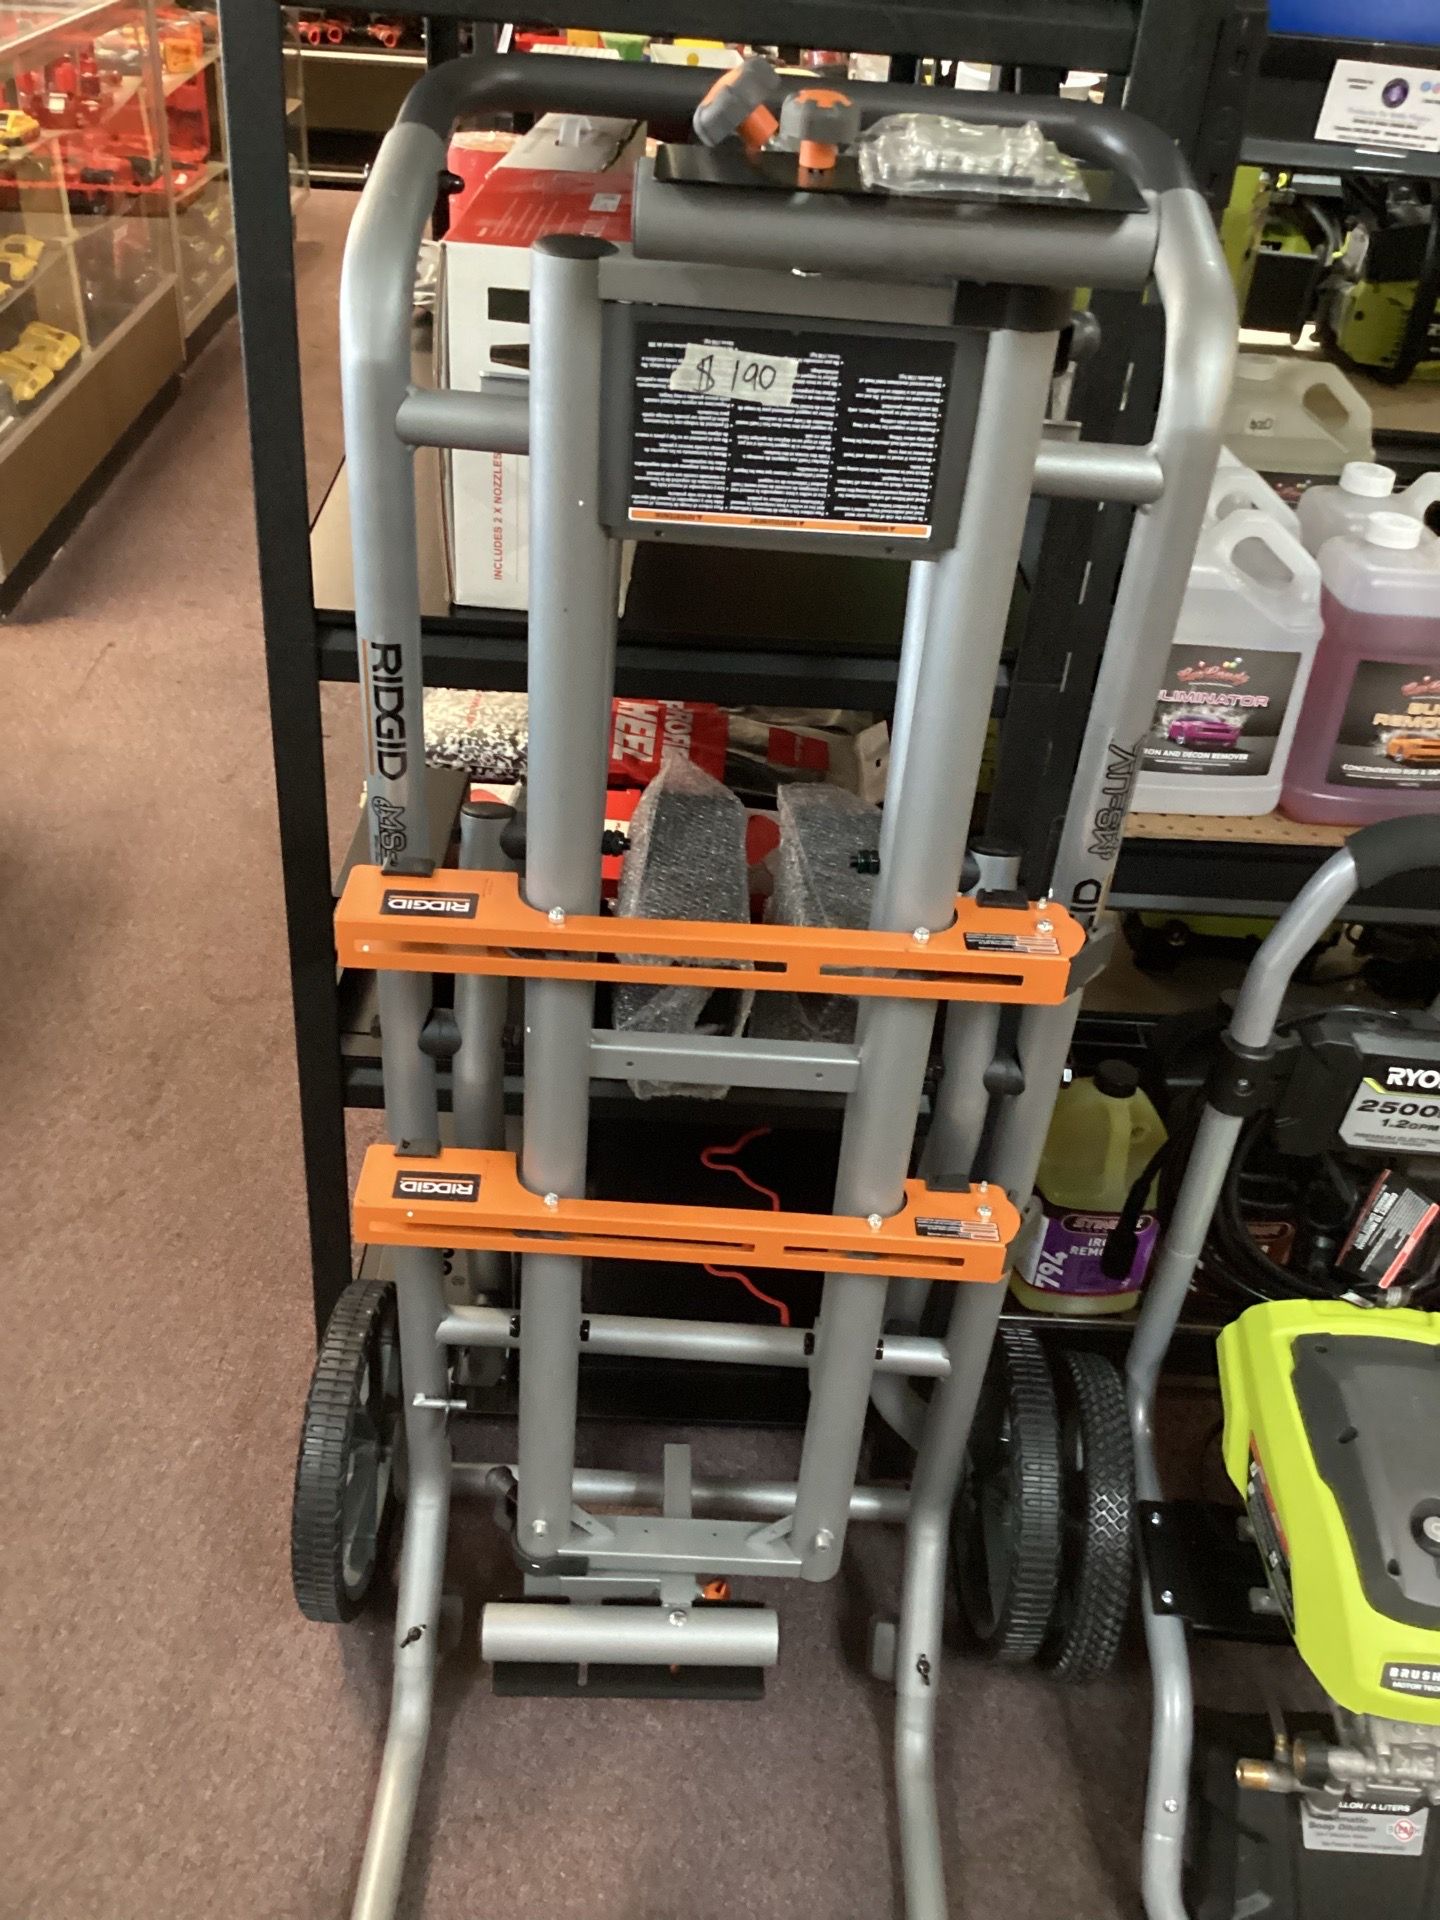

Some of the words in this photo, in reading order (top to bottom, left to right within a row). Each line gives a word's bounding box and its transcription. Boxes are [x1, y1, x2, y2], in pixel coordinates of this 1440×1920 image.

[493, 452, 503, 504] NOZZLES
[493, 526, 503, 580] INCLUDES
[1158, 689, 1269, 708] LIMINATOR
[371, 642, 408, 781] RIDGID
[1373, 712, 1440, 729] REMO
[1163, 749, 1181, 757] AND
[1211, 752, 1249, 761] REMOVER
[387, 899, 470, 912] RIDGID
[1386, 1066, 1440, 1089] RYO
[1356, 1099, 1440, 1118] 2500
[400, 1181, 474, 1195] RIDGID
[1034, 1250, 1069, 1289] 794
[1379, 1804, 1412, 1812] LITERS
